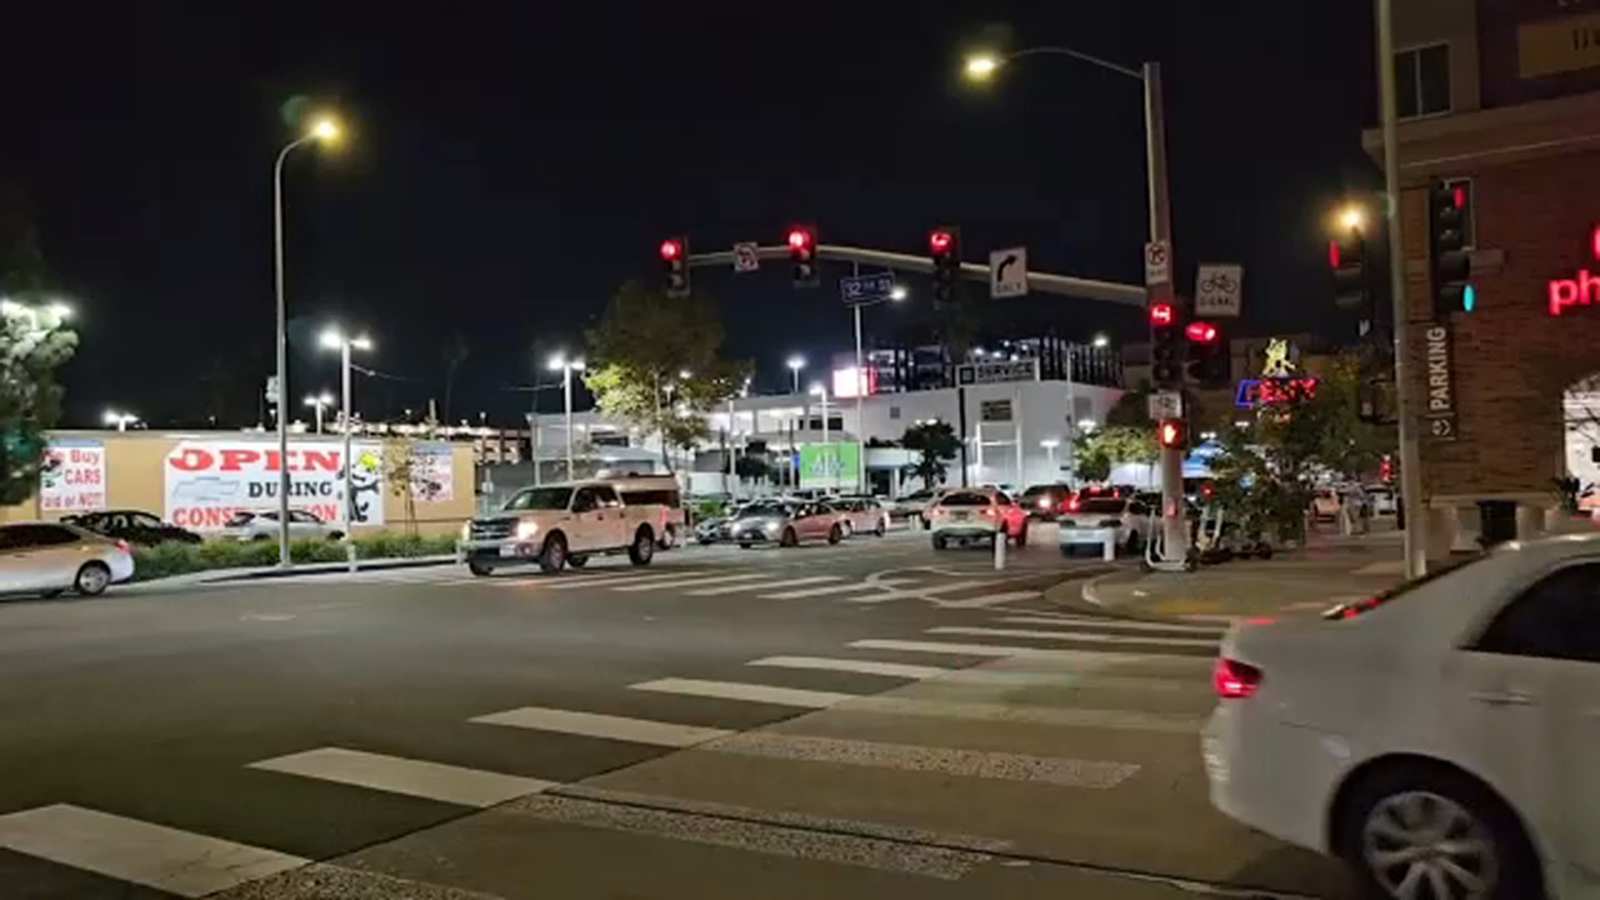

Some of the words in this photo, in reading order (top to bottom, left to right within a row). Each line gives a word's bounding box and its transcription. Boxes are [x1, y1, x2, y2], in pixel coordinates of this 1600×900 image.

[1426, 326, 1450, 410] PARKING
[70, 450, 100, 465] Buy
[169, 448, 341, 472] OPEN
[65, 469, 101, 485] CARS
